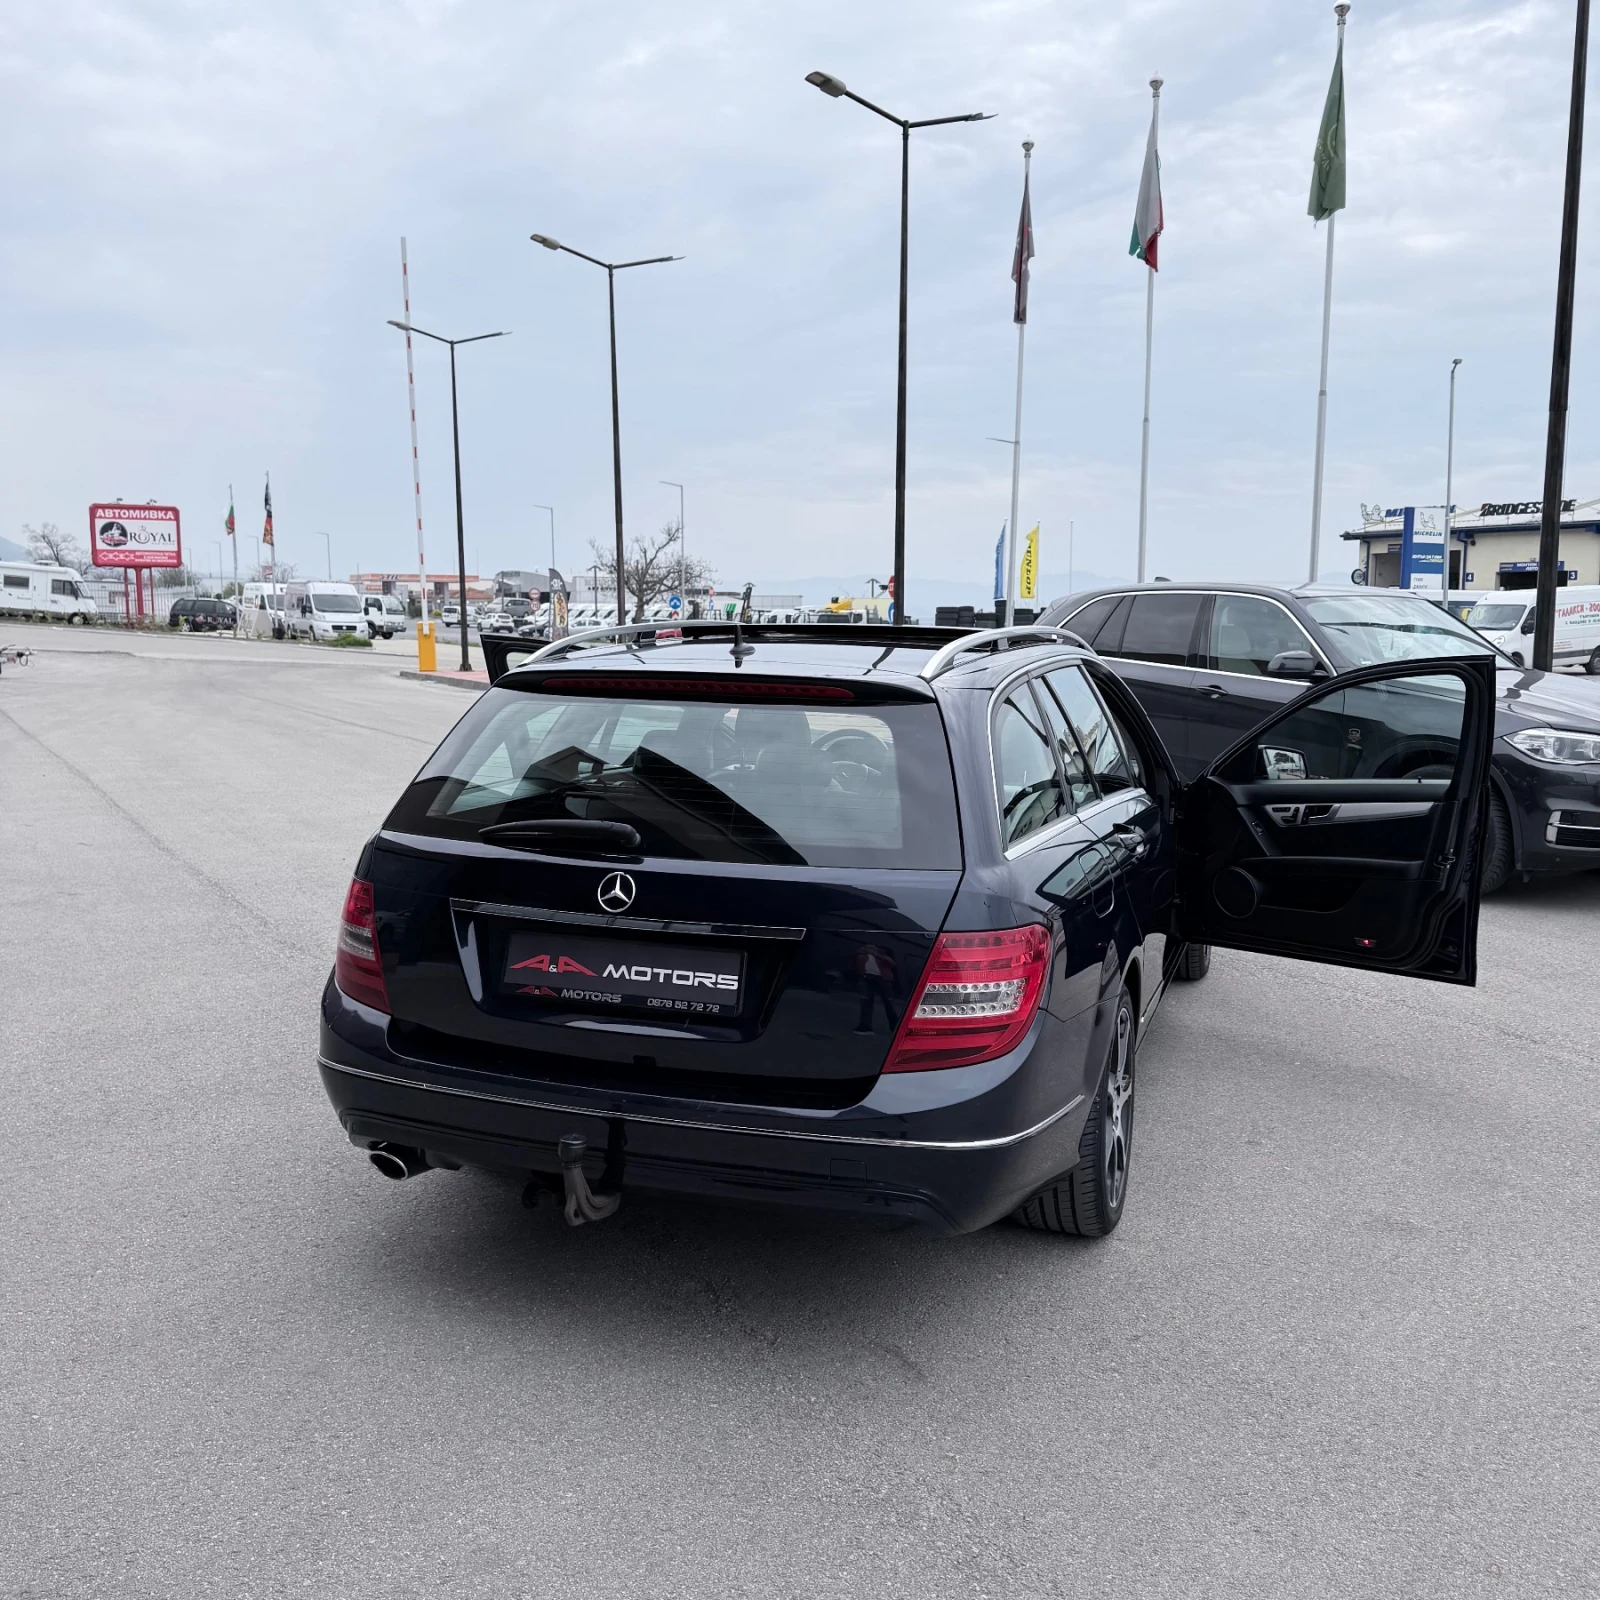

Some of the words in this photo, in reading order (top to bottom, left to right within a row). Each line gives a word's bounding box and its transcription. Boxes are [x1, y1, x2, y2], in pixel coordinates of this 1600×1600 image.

[96, 508, 175, 520] АВТОМИВКА
[129, 532, 175, 544] ROYAL
[508, 954, 598, 977] A&A
[602, 963, 739, 990] MOTORS
[515, 985, 559, 998] A&A
[560, 988, 622, 1004] MOTORS
[690, 1003, 704, 1011] 72
[706, 1004, 720, 1013] 72
